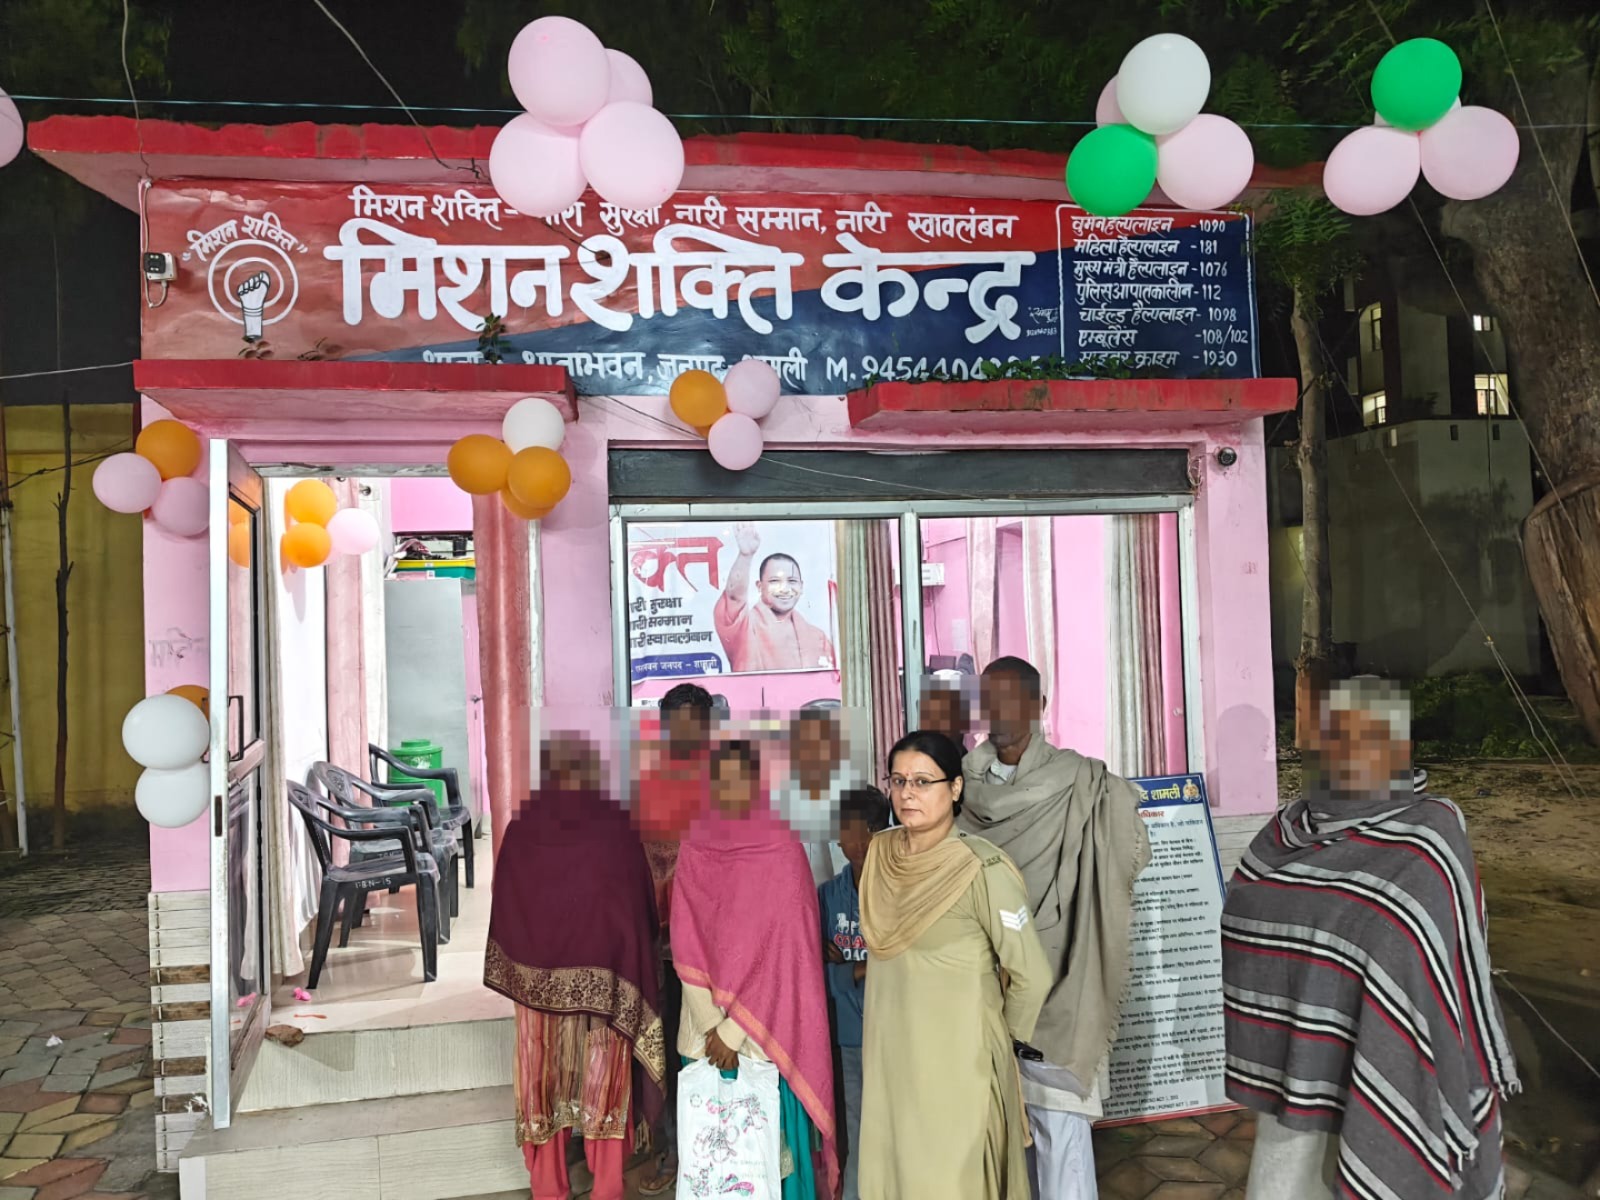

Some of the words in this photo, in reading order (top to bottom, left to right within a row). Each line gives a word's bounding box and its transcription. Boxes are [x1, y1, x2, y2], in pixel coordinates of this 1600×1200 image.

[348, 184, 427, 224] मिशन
[431, 188, 503, 231] शक्ति
[672, 195, 727, 229] नारी
[835, 201, 893, 234] नारी
[908, 206, 1020, 243] स्वावलंबन
[323, 218, 571, 333] मिशन
[571, 222, 805, 334] शक्ति
[820, 231, 1036, 345] केन्द्र
[1208, 307, 1237, 323] 1098
[630, 596, 647, 613] ारी
